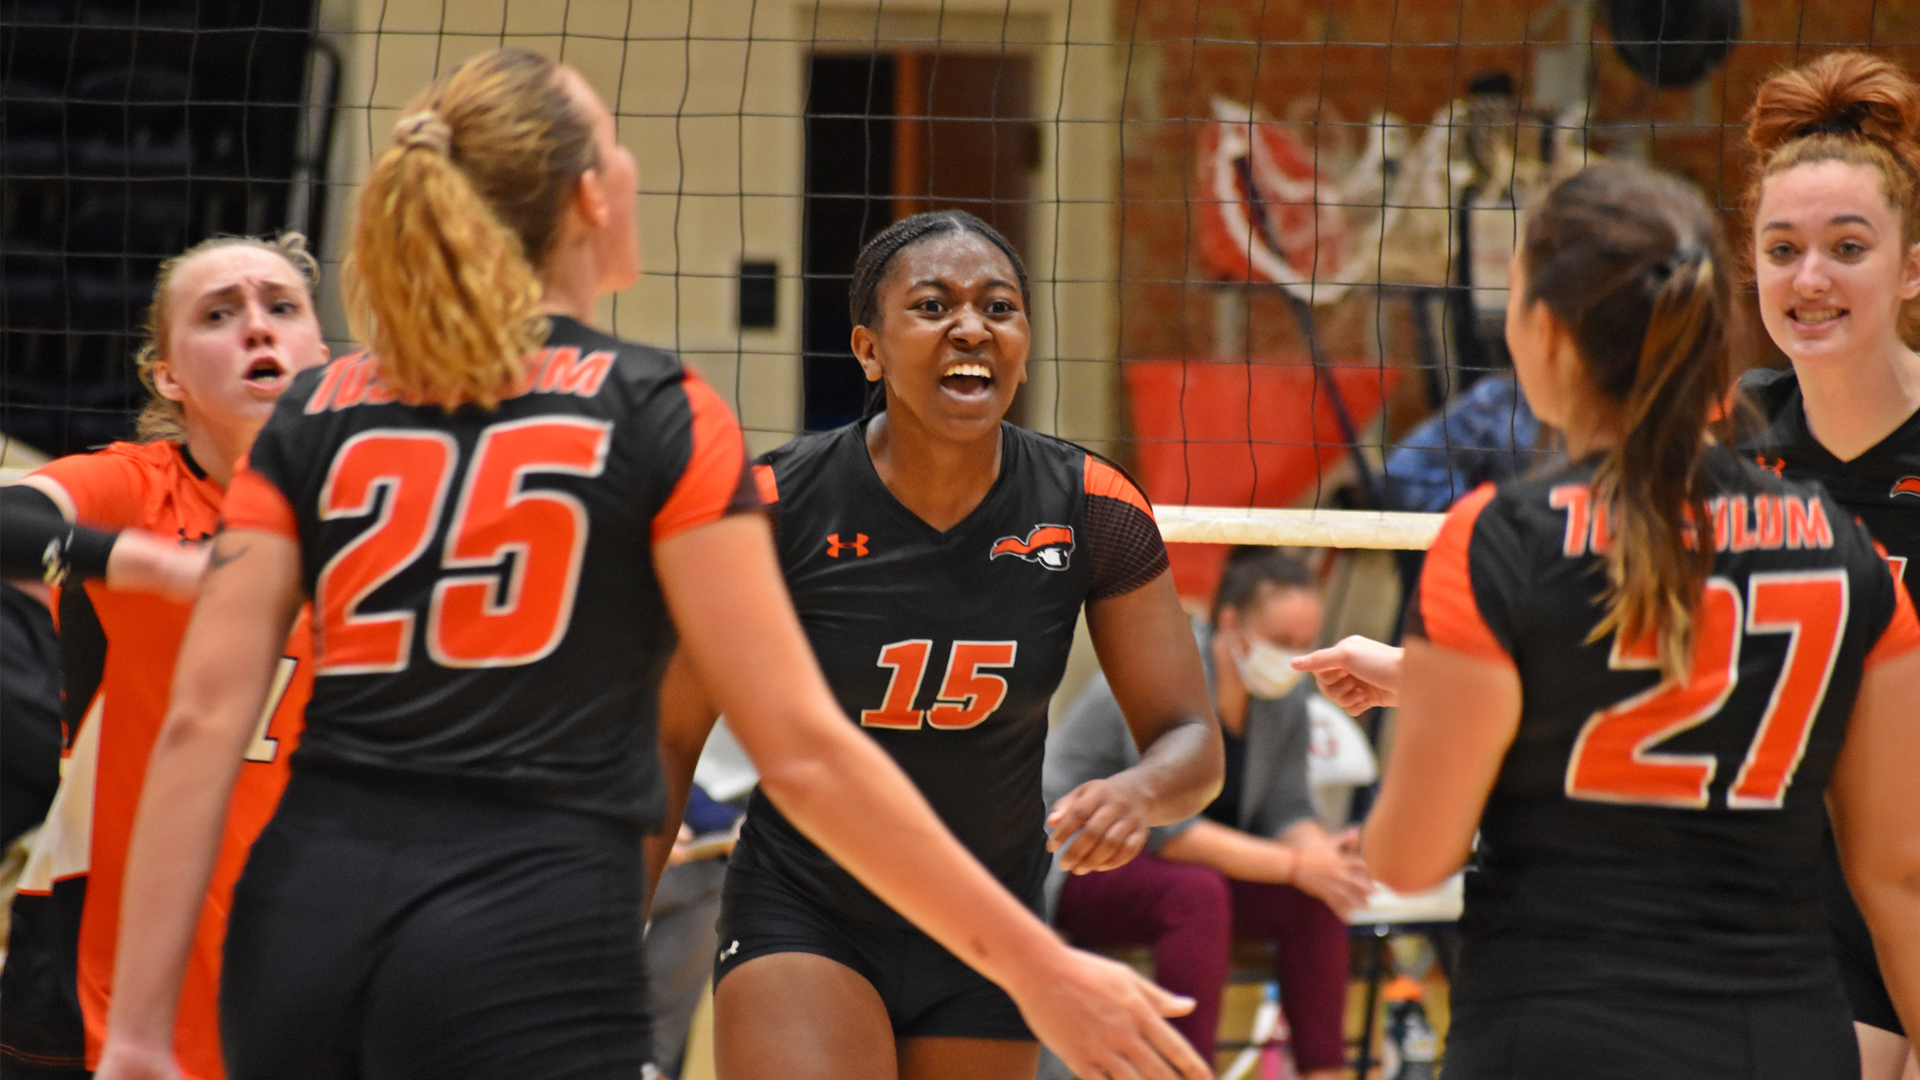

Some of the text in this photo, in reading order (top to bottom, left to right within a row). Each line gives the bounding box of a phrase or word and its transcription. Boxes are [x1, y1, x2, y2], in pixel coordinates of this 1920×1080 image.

[315, 414, 614, 676] 25
[860, 638, 1018, 731] 15
[1564, 569, 1850, 810] 27
